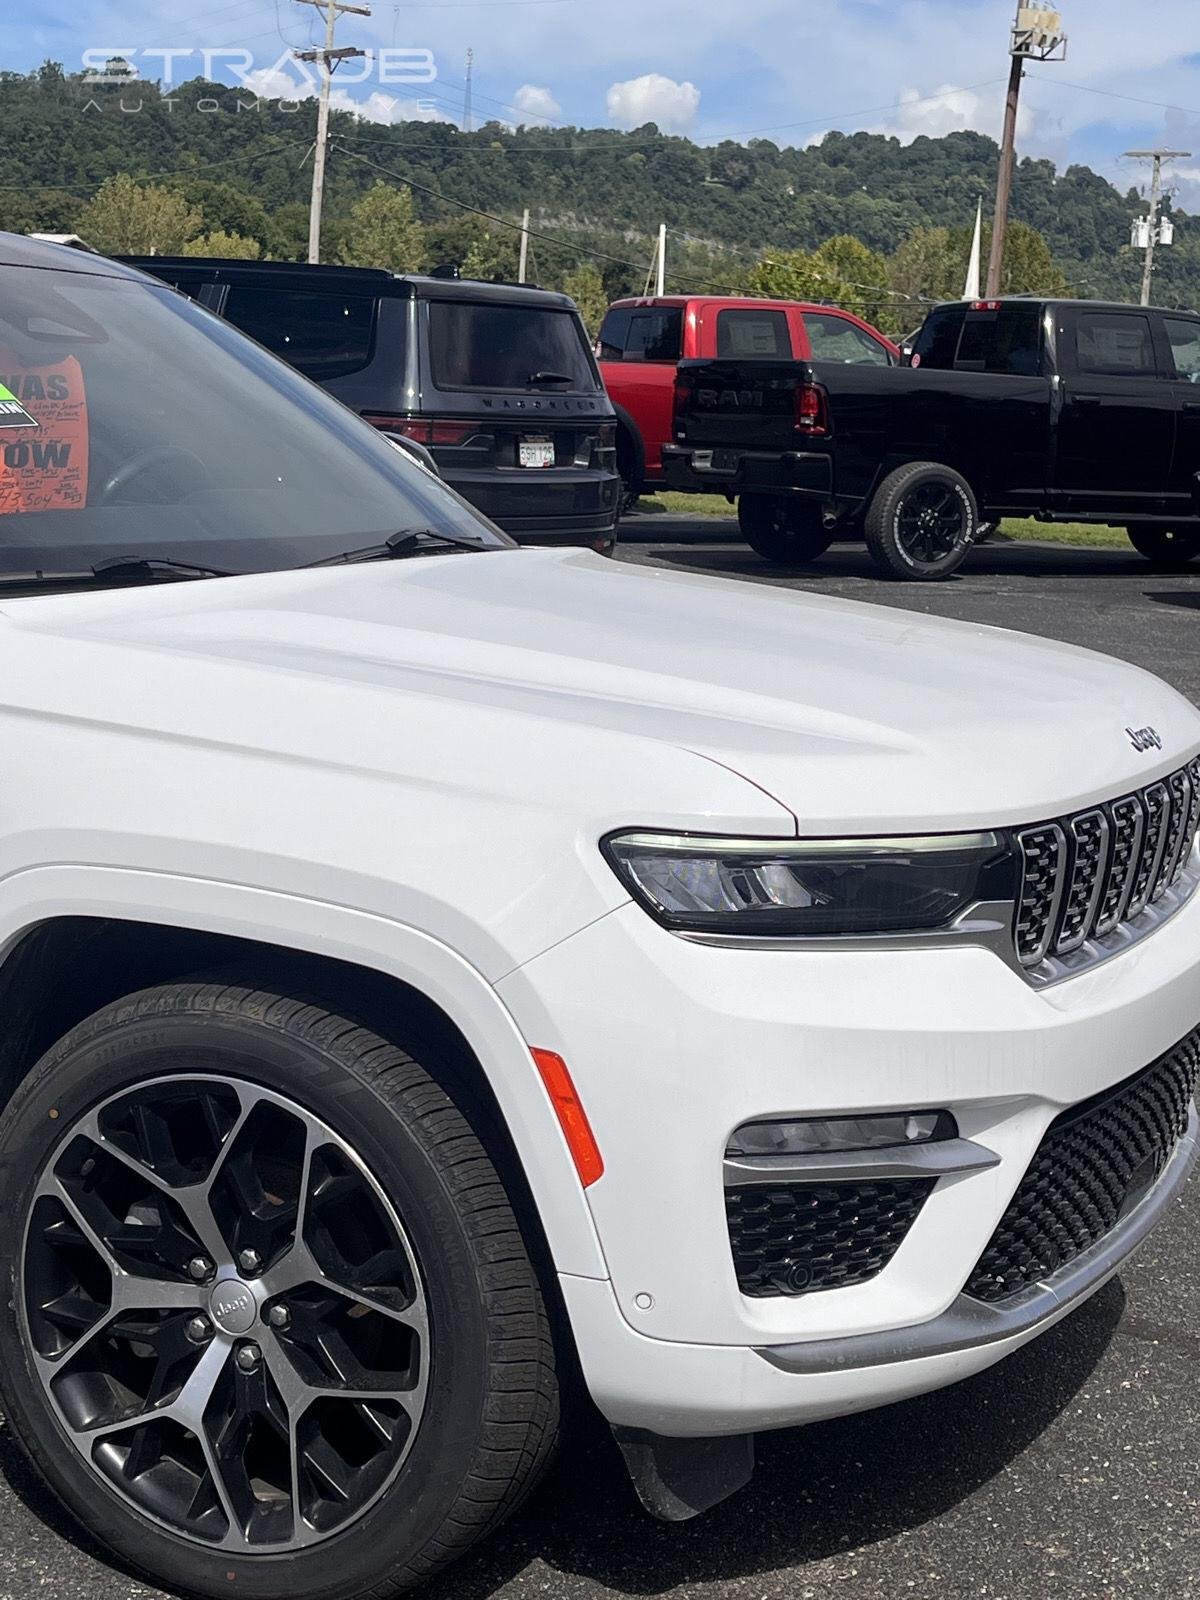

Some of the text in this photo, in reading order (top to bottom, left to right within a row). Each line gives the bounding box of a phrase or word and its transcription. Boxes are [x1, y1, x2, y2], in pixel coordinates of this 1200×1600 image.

[482, 399, 596, 410] WAGONEER
[697, 389, 764, 407] RAM
[1124, 726, 1162, 752] Jeep
[216, 1295, 248, 1316] Jeep
